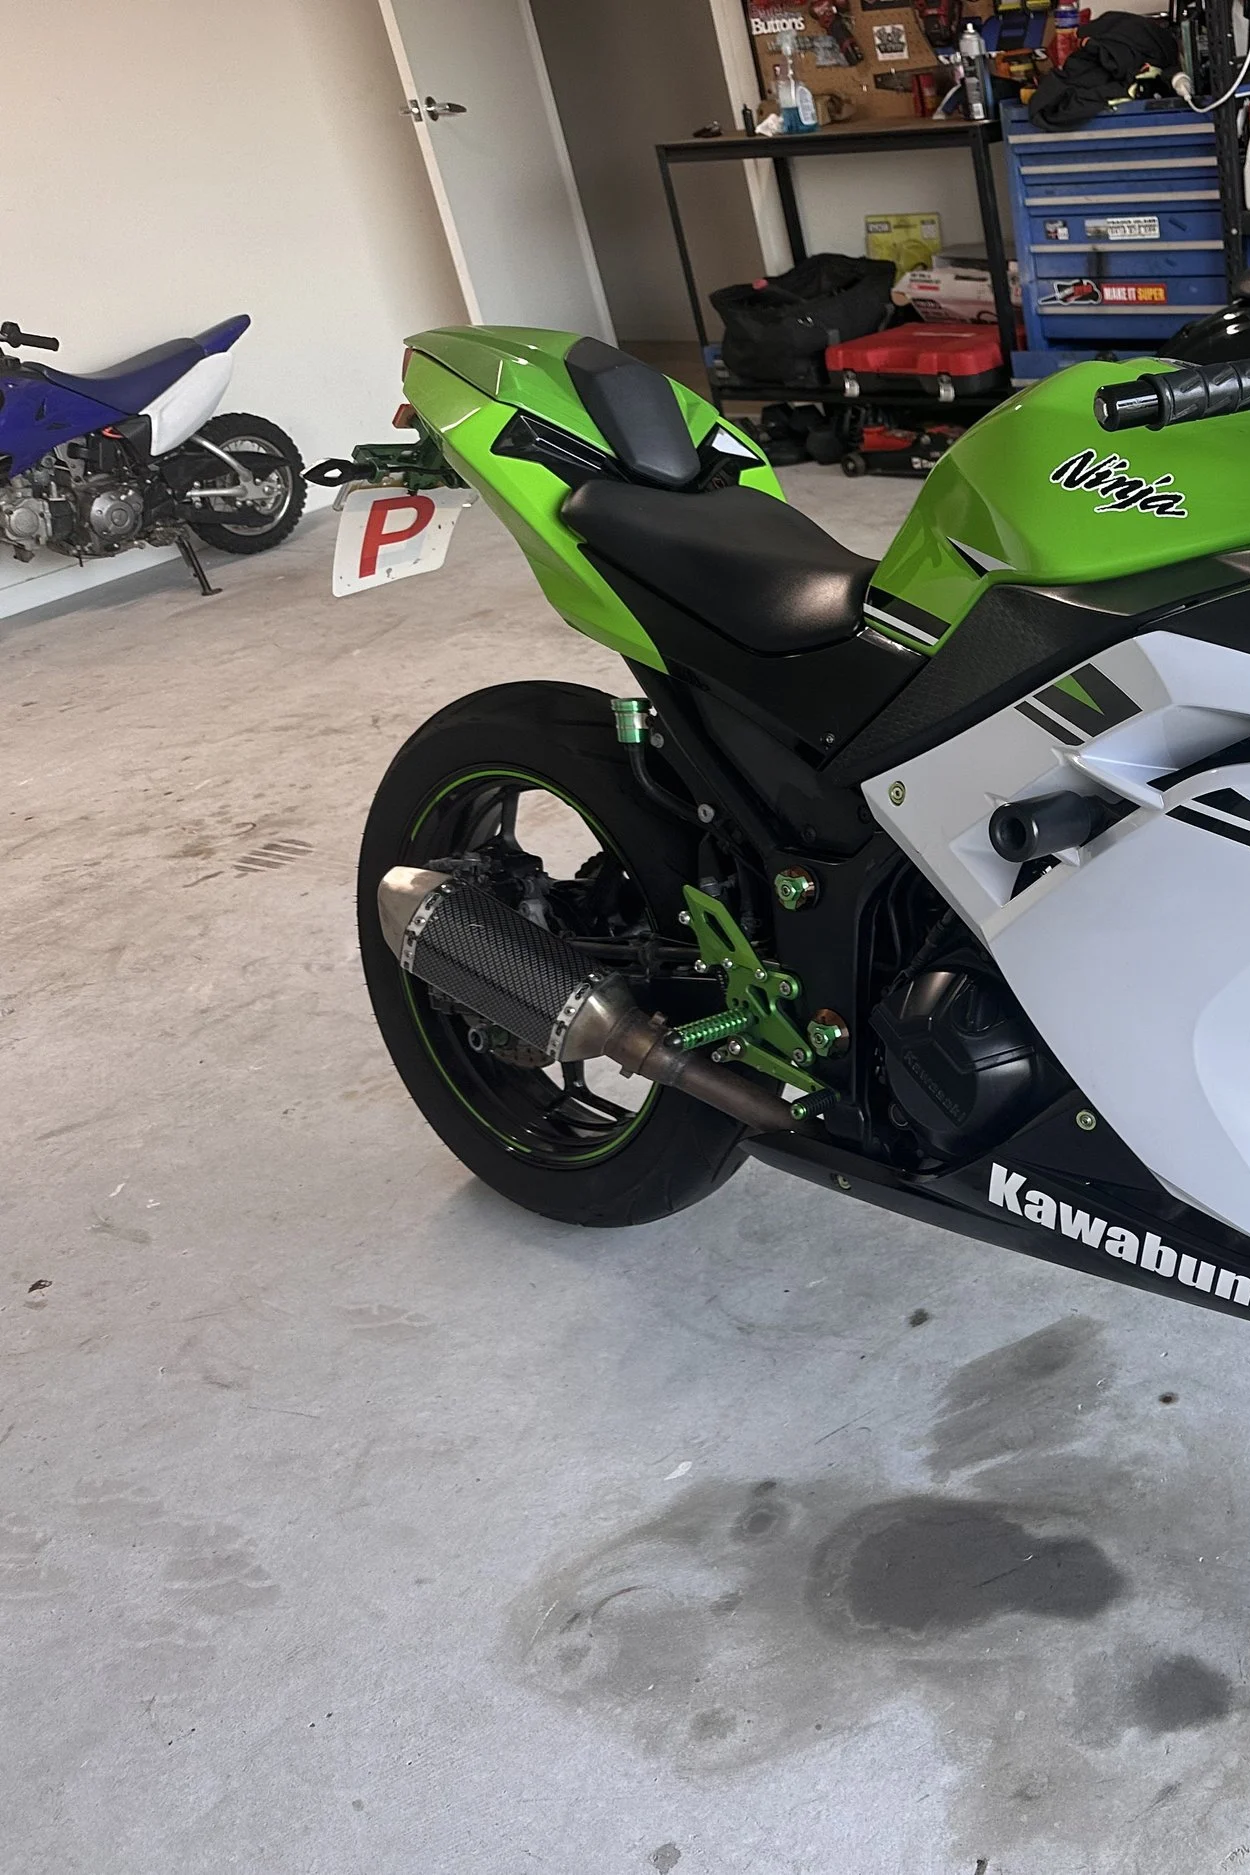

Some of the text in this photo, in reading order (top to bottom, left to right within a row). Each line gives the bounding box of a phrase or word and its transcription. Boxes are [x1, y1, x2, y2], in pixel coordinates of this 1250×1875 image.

[751, 17, 804, 35] Buttons
[1103, 287, 1126, 301] MAKE
[1127, 287, 1136, 300] IT
[1137, 287, 1166, 301] SUPER
[1050, 448, 1188, 518] Ninja
[359, 495, 435, 579] P
